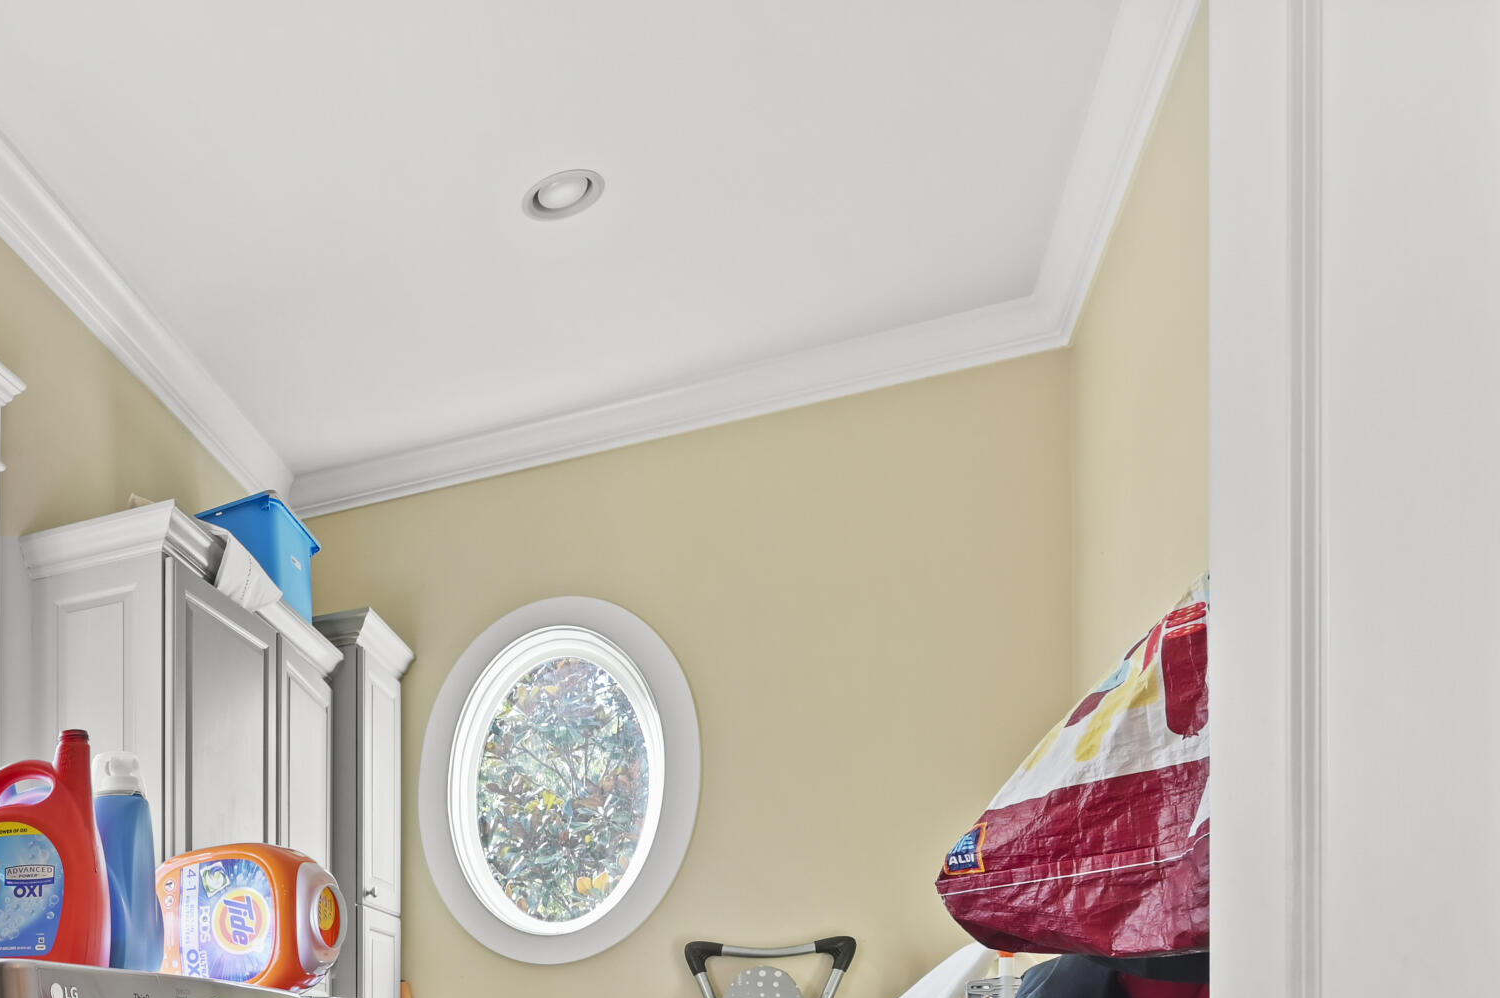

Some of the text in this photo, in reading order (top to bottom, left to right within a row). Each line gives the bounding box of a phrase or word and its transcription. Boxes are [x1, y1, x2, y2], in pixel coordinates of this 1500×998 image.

[948, 853, 976, 866] ALDI
[6, 865, 53, 876] ADVANCED
[14, 884, 44, 898] OXI
[223, 894, 255, 947] Tide
